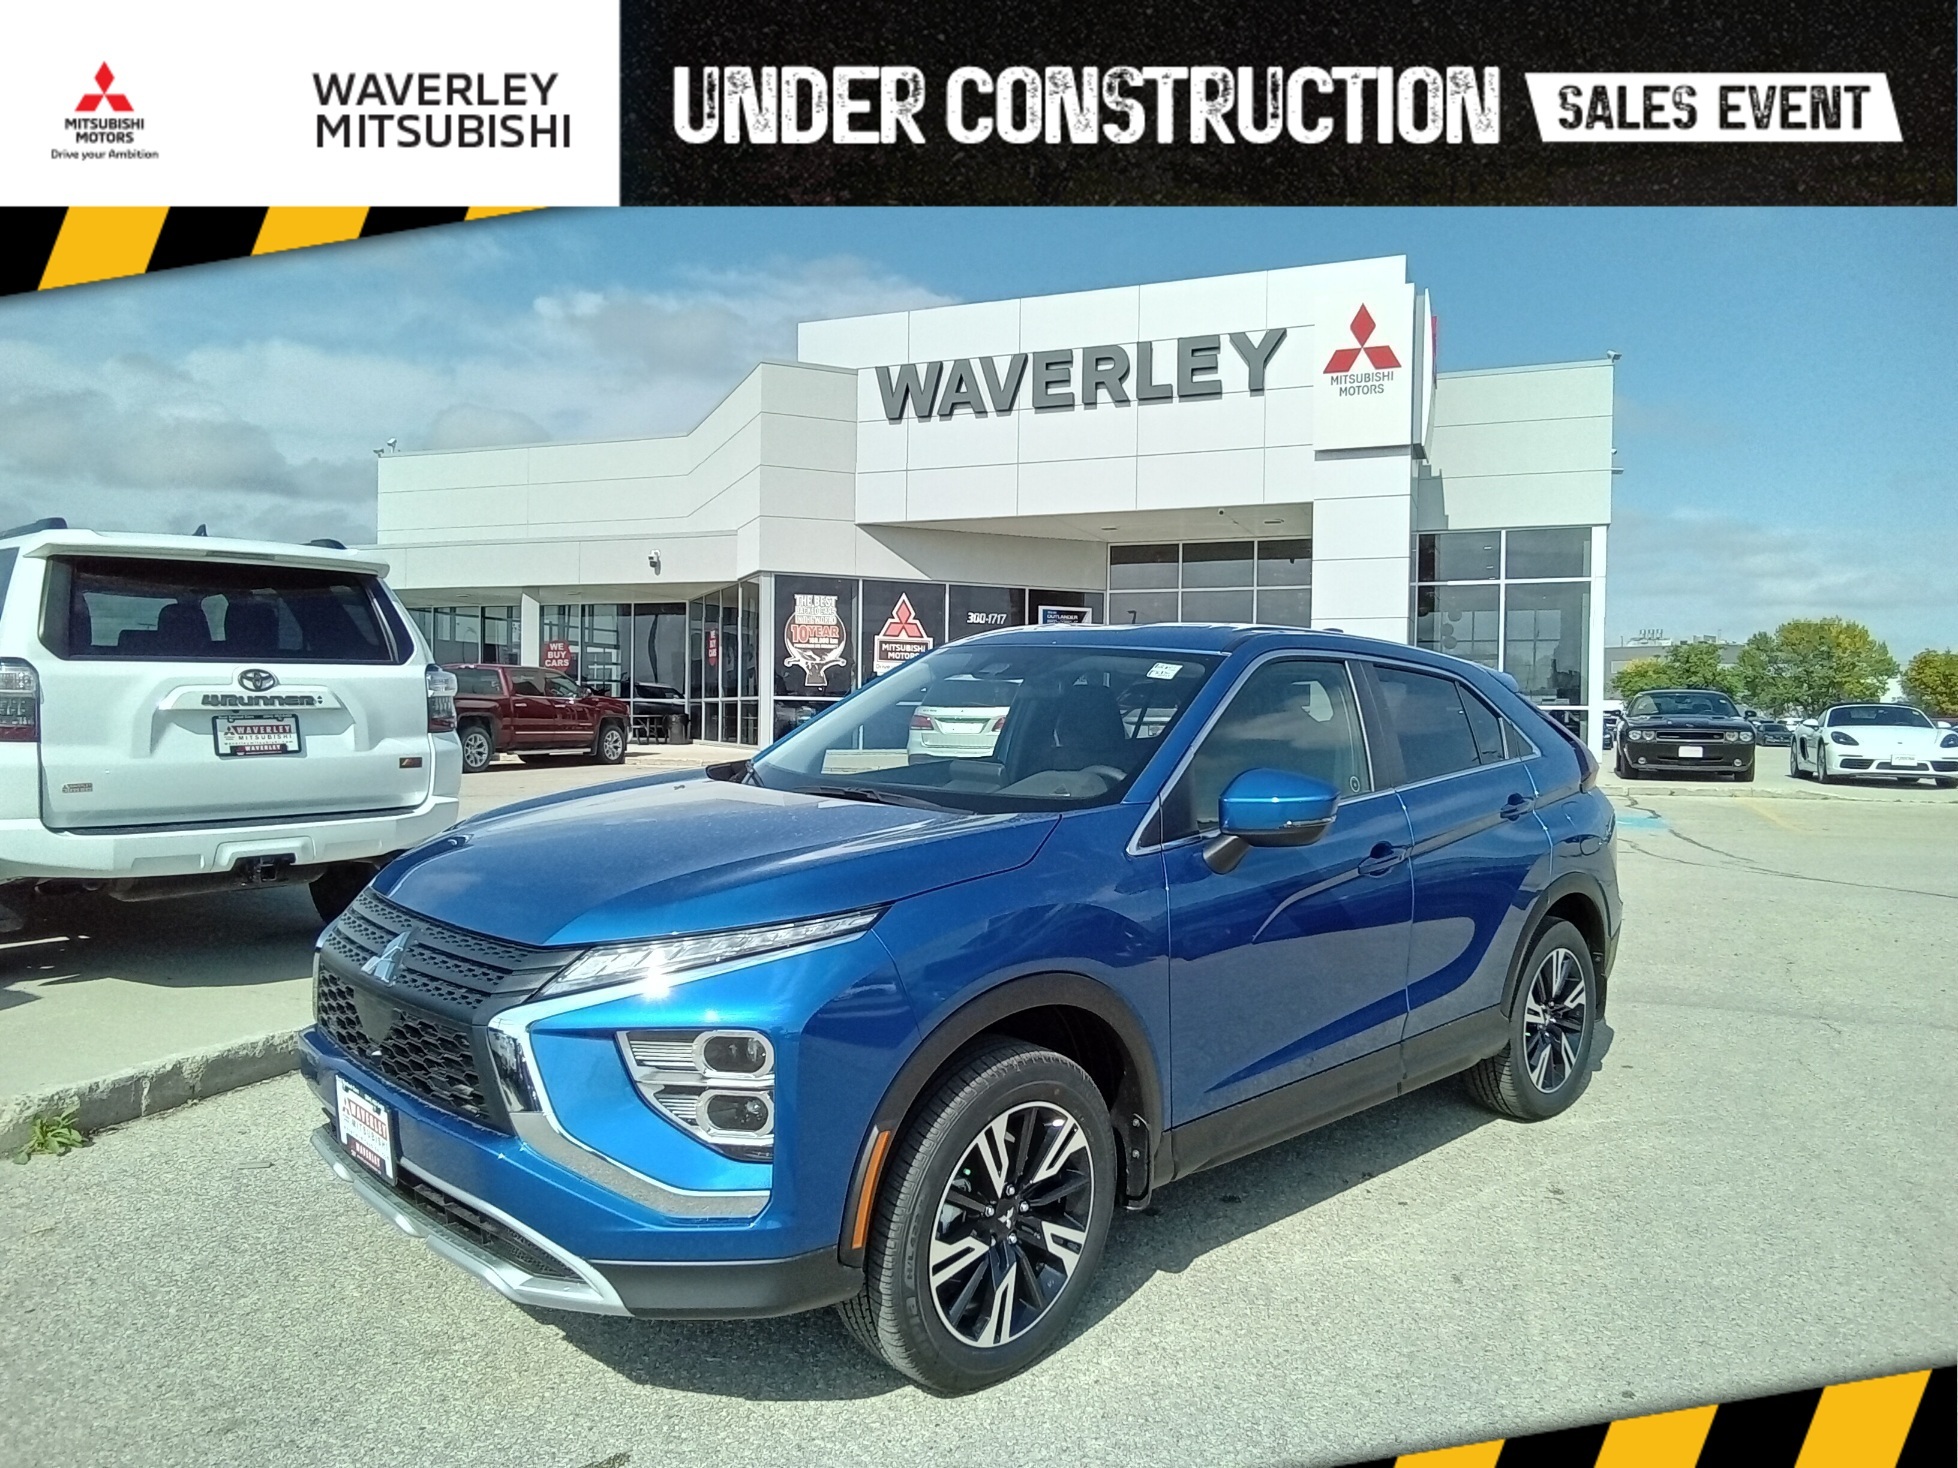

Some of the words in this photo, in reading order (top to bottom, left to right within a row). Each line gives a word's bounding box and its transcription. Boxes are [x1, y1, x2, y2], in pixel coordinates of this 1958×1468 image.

[875, 328, 1288, 420] WAVERLEY
[1330, 370, 1394, 386] MITSUBISHI
[1339, 383, 1385, 397] MOTORS
[815, 594, 838, 607] BEST
[966, 612, 1007, 625] 300-1717
[792, 624, 809, 643] 10
[808, 625, 839, 638] YEAR
[549, 642, 565, 651] WE
[881, 643, 926, 652] MITSUBISHI
[547, 651, 567, 659] BUY
[545, 659, 570, 667] CARS
[235, 725, 291, 734] WAVERLEY
[348, 1101, 387, 1140] WAVERLEY
